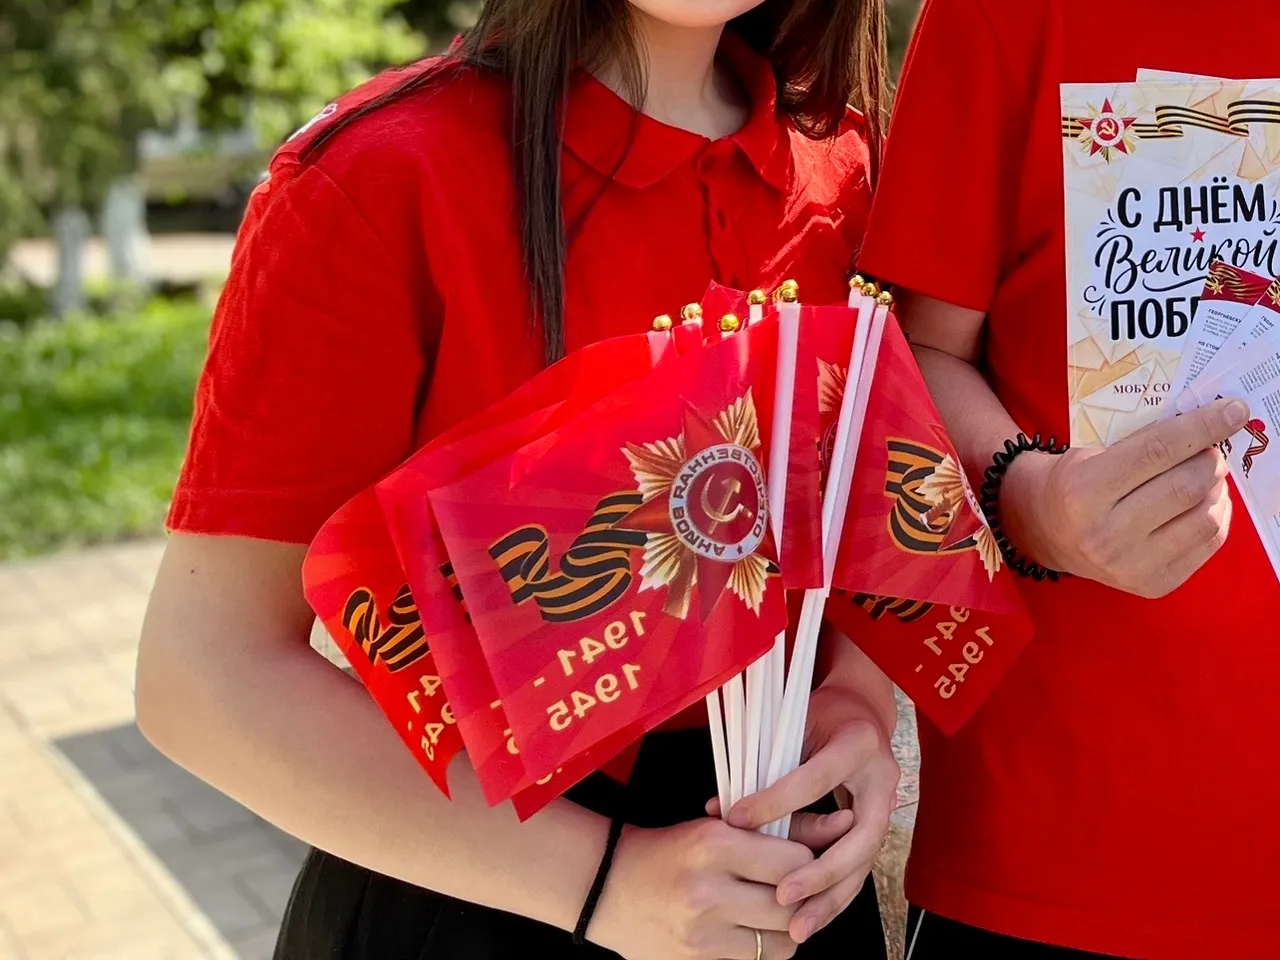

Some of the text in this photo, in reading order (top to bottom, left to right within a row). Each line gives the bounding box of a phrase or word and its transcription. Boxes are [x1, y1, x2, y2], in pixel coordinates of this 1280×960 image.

[1117, 187, 1142, 228] С
[1153, 176, 1266, 233] ДНЁМ
[1113, 384, 1149, 394] МОБУ
